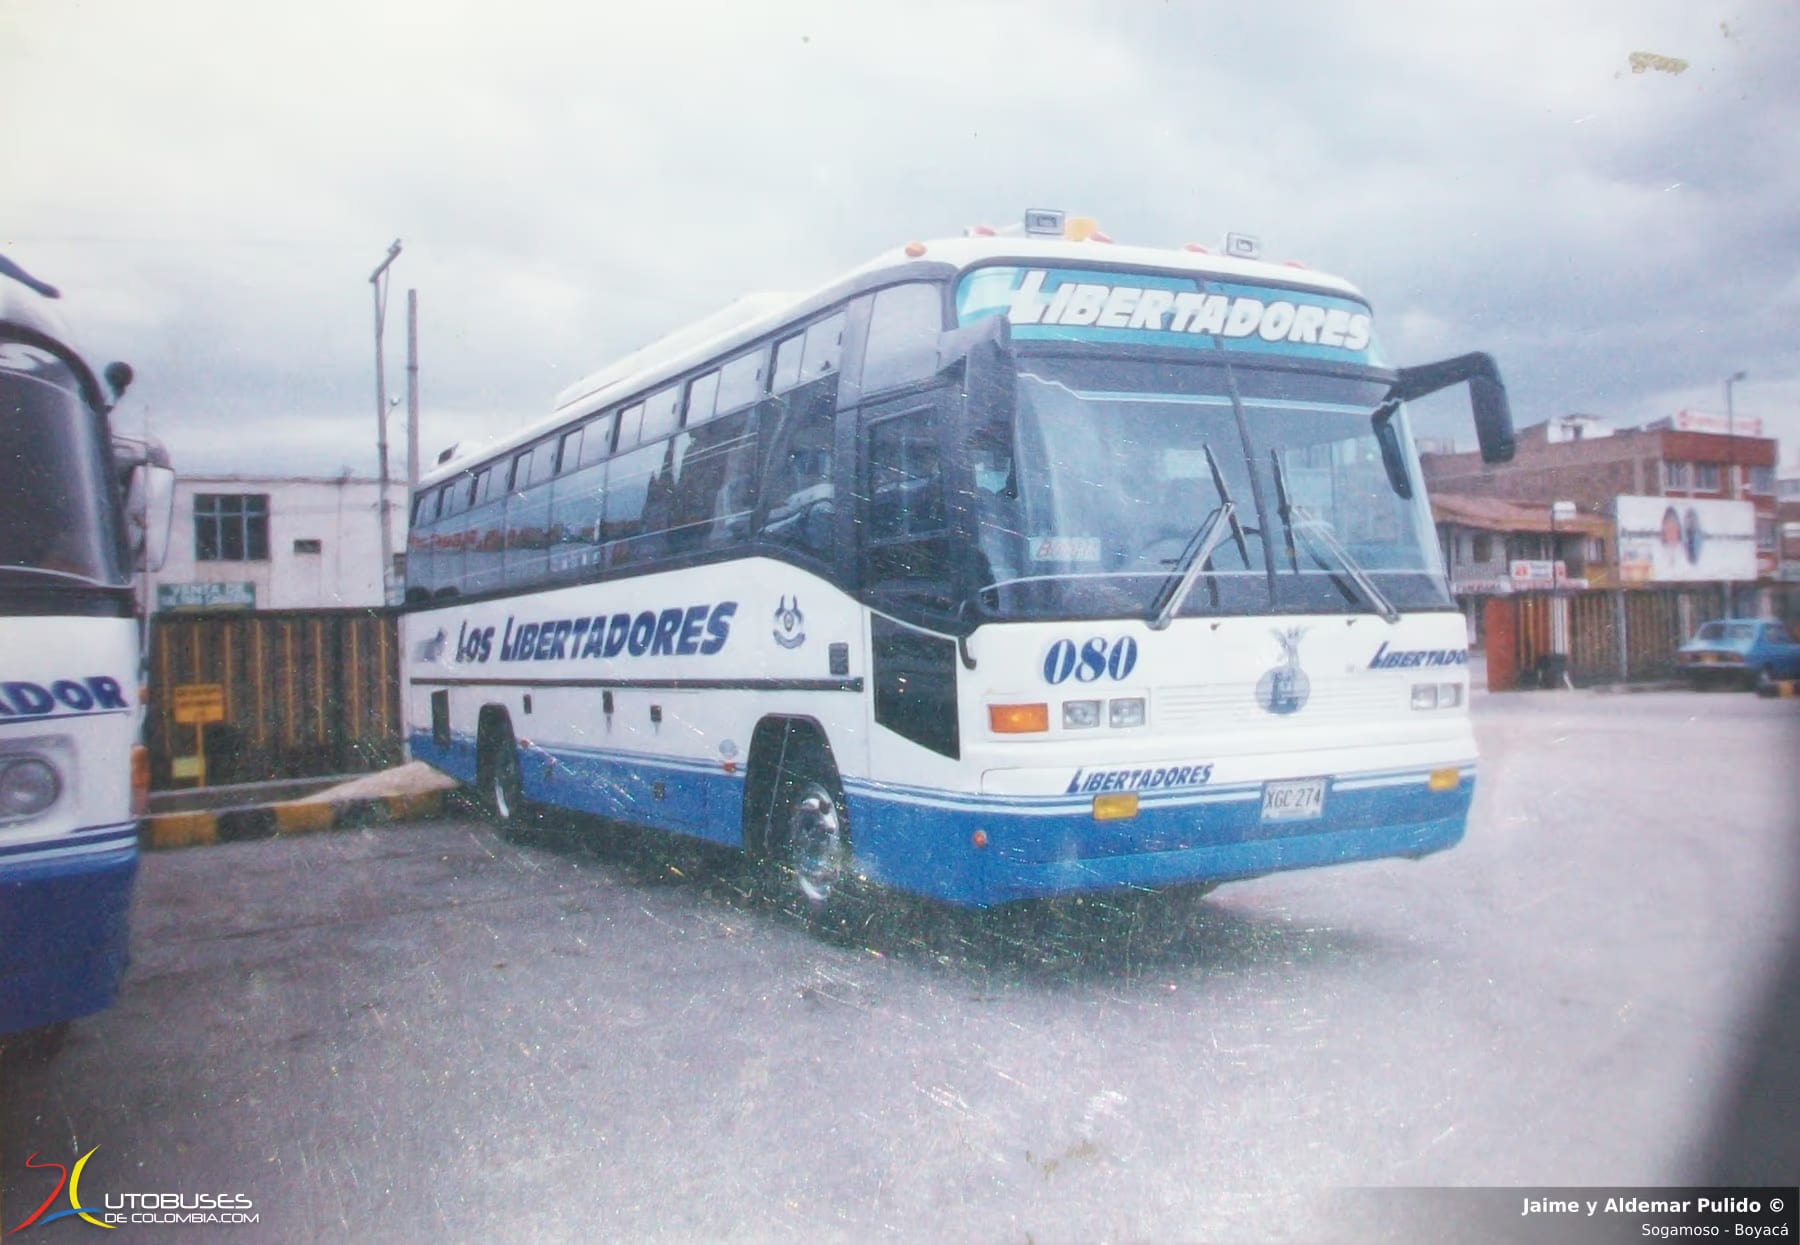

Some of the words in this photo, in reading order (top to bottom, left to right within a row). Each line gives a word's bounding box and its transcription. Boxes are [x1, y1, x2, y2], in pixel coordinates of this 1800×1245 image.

[1008, 270, 1370, 350] LIBERTADORES
[456, 620, 496, 663] LOS
[499, 601, 738, 661] LIBERTADORES
[1043, 635, 1138, 685] 080
[1066, 764, 1214, 794] LIBERTADORES
[1295, 787, 1321, 807] 274
